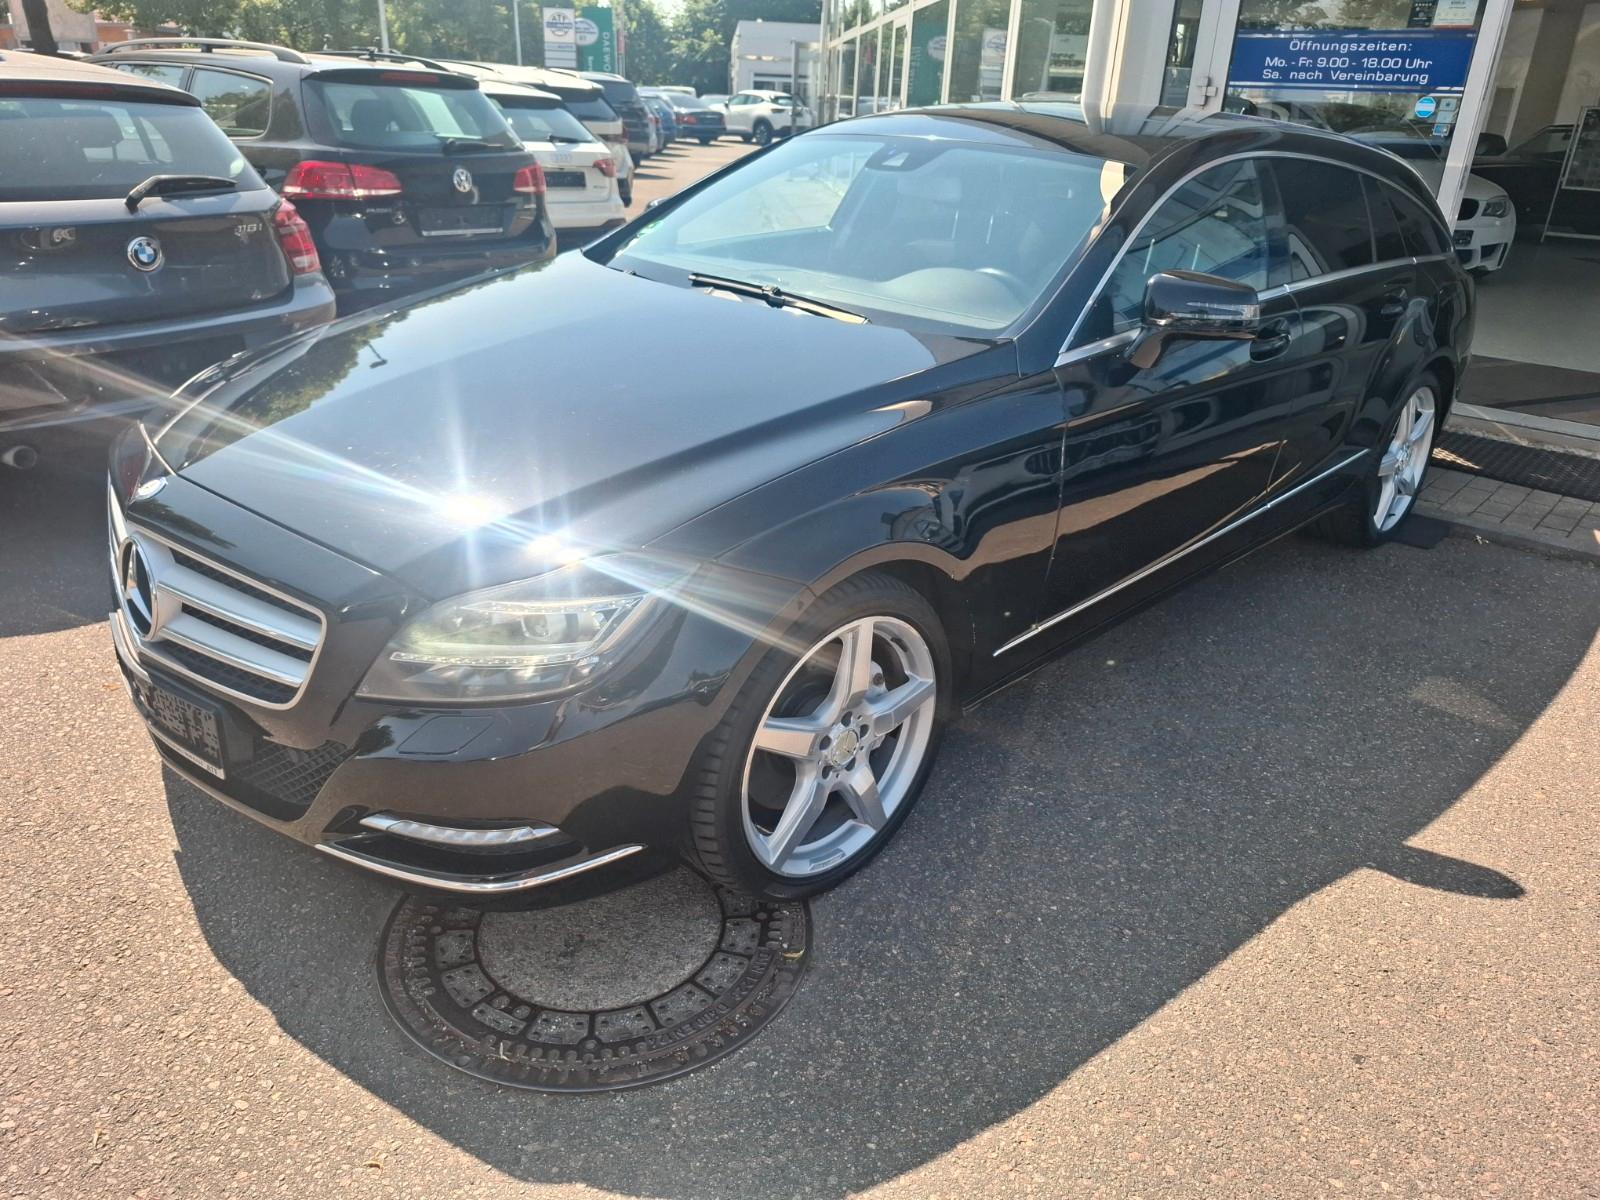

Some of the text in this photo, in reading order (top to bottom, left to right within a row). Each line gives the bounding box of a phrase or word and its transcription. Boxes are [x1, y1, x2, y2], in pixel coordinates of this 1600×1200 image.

[1289, 39, 1413, 53] Öffnungszeiten:
[1264, 56, 1288, 67] Mo.
[1298, 57, 1313, 68] Fr.
[1316, 57, 1349, 68] 9.00
[1362, 57, 1401, 69] 18.00
[1405, 58, 1433, 69] Uhr
[1262, 68, 1429, 84] Sa. nach Vereinbarung
